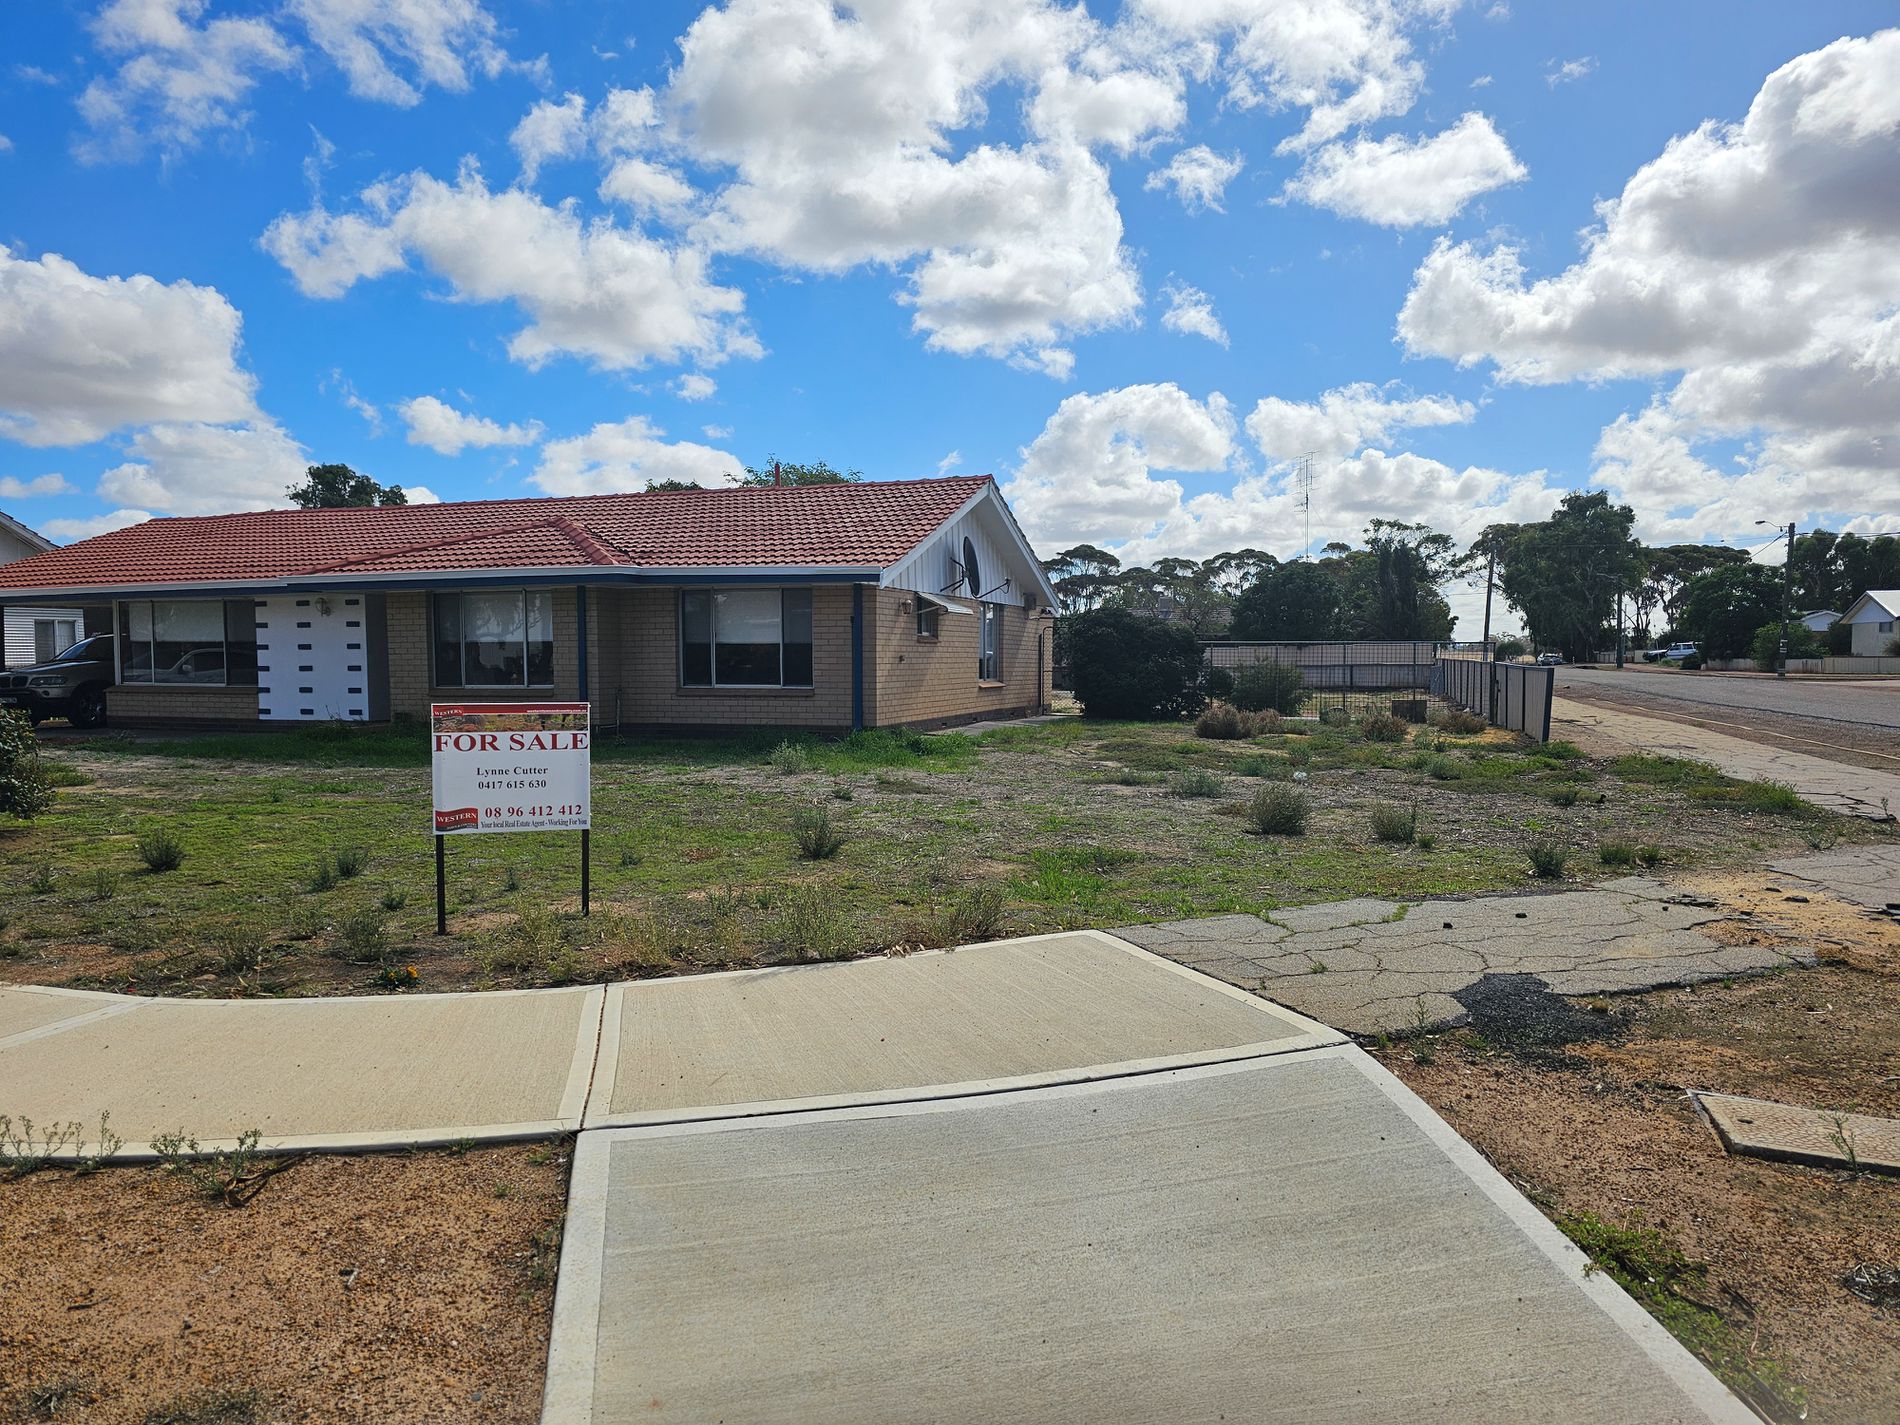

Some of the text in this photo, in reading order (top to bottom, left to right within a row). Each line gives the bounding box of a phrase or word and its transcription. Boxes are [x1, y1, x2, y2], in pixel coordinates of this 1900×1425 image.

[433, 733, 588, 752] FOR SALE
[476, 766, 549, 778] Lynne Cutter
[478, 779, 547, 790] 0417 615 630
[485, 804, 582, 818] 08 96 412 412
[436, 812, 477, 823] WESTERN
[505, 820, 516, 828] Real
[516, 820, 531, 828] Estate
[532, 820, 545, 828] Agent
[548, 818, 569, 827] Working
